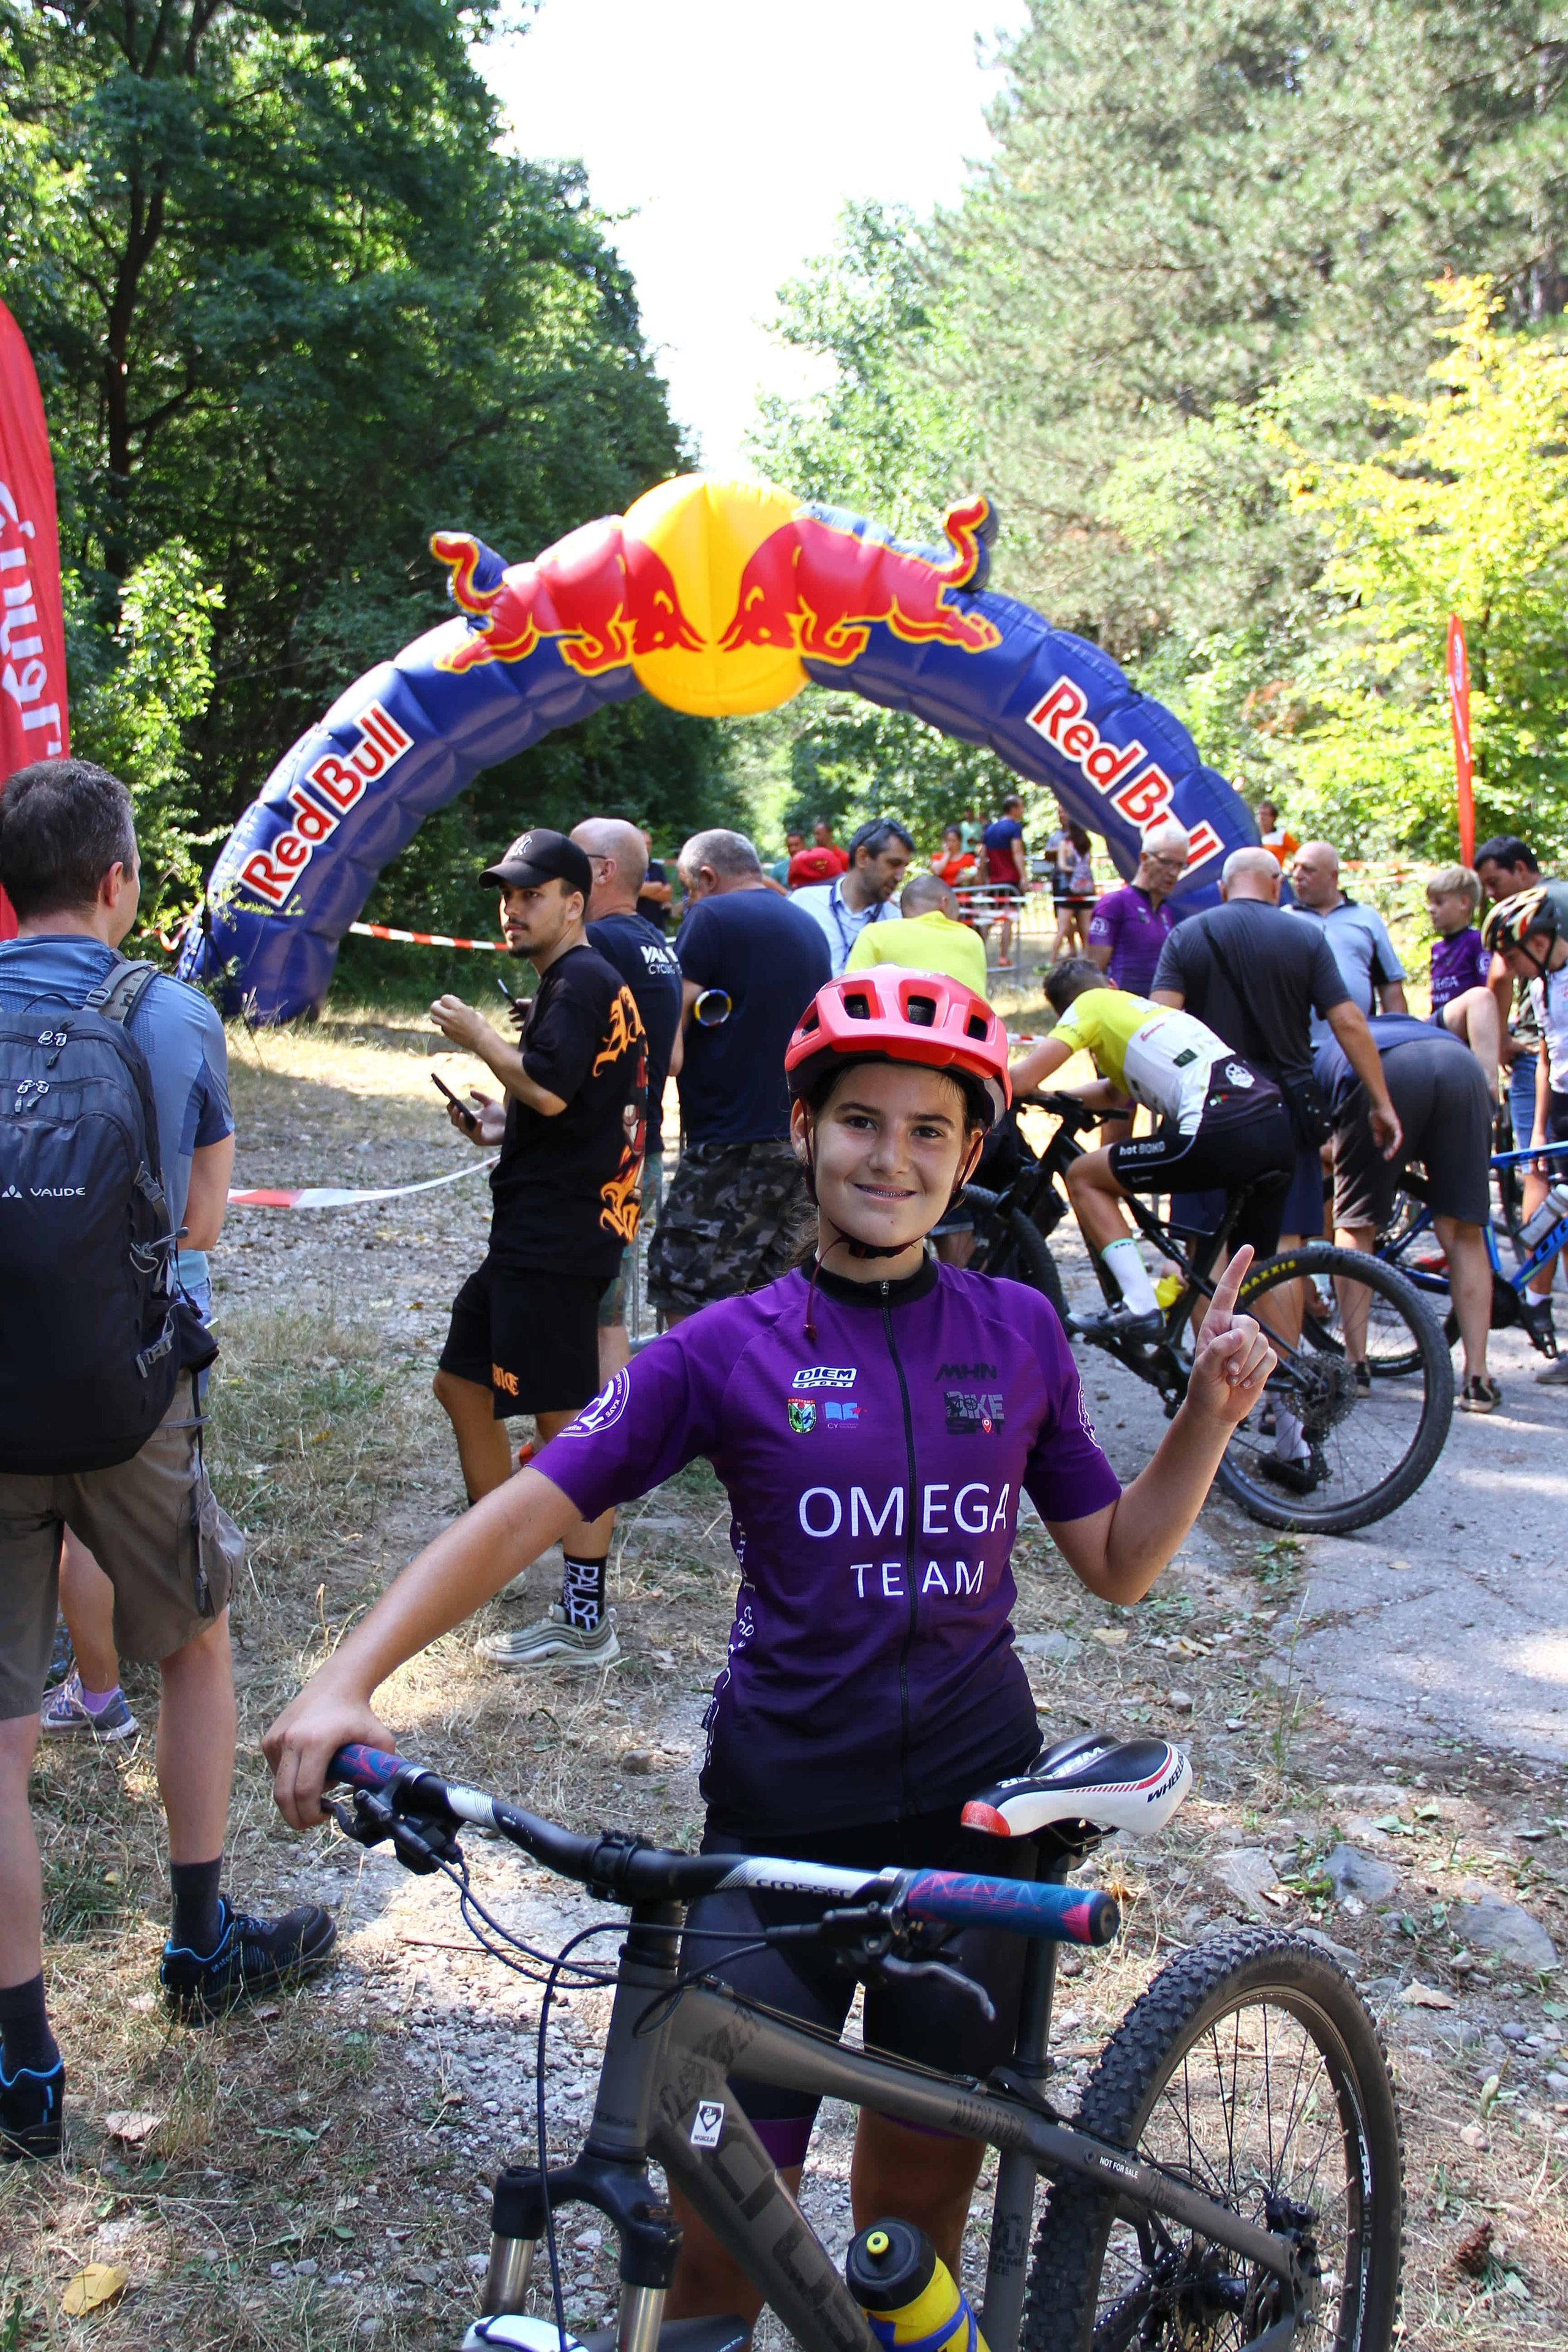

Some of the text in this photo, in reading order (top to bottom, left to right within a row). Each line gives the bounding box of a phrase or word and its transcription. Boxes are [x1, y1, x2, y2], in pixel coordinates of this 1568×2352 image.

[1029, 678, 1219, 870] Red Bll
[239, 704, 412, 903] Red Bull
[30, 1186, 86, 1197] VAUDE
[1240, 1259, 1297, 1297] MAXXIS
[797, 1368, 853, 1381] DIEM
[935, 1363, 996, 1381] MHN
[799, 1482, 1011, 1537] OMEGA
[567, 1561, 600, 1630] PAUSE
[850, 1560, 985, 1598] TEAM
[1099, 2157, 1139, 2179] NOT FOR SALE
